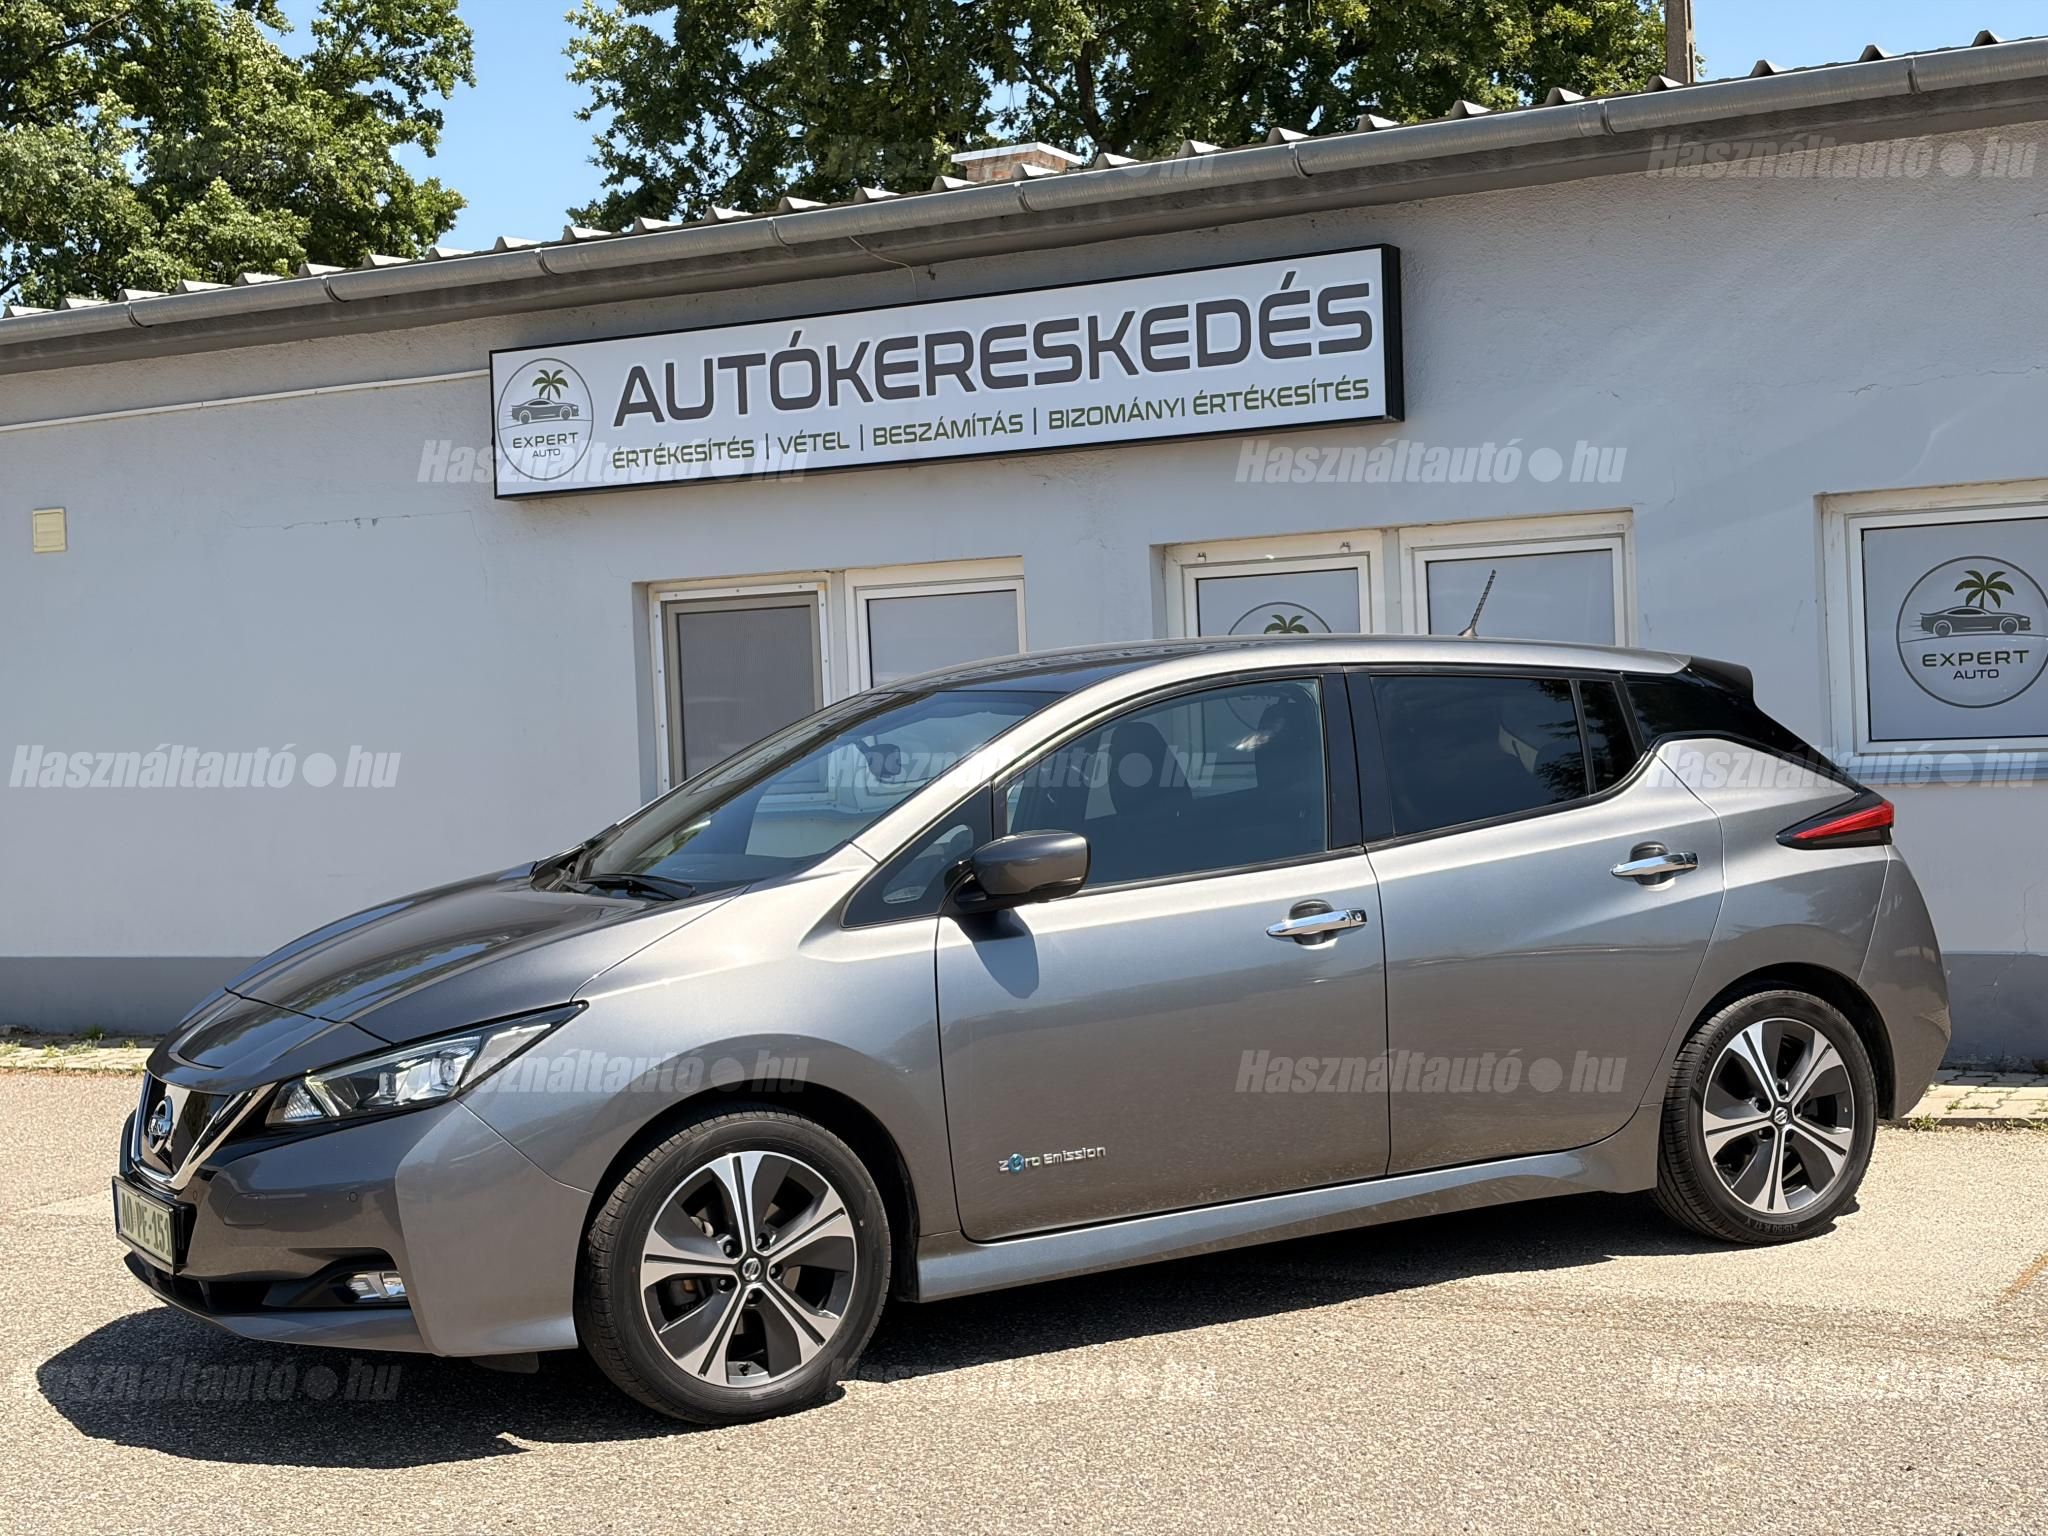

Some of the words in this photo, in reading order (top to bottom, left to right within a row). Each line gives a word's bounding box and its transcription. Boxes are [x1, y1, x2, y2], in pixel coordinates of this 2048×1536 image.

[613, 271, 1373, 427] AUTÓKERESKEDÉS
[612, 436, 755, 469] ÉRTÉKESÍTÉS
[778, 430, 850, 455] VÉTEL
[873, 409, 1024, 446] BESZÁMÍTÁS
[1049, 397, 1186, 430] BIZOMÁNYI
[1192, 375, 1369, 416] ÉRTÉKESÍTÉS
[512, 432, 579, 449] EXPERT
[532, 448, 561, 458] AUTO
[1921, 650, 2029, 667] EXPERT
[1953, 669, 1999, 680] AUTO
